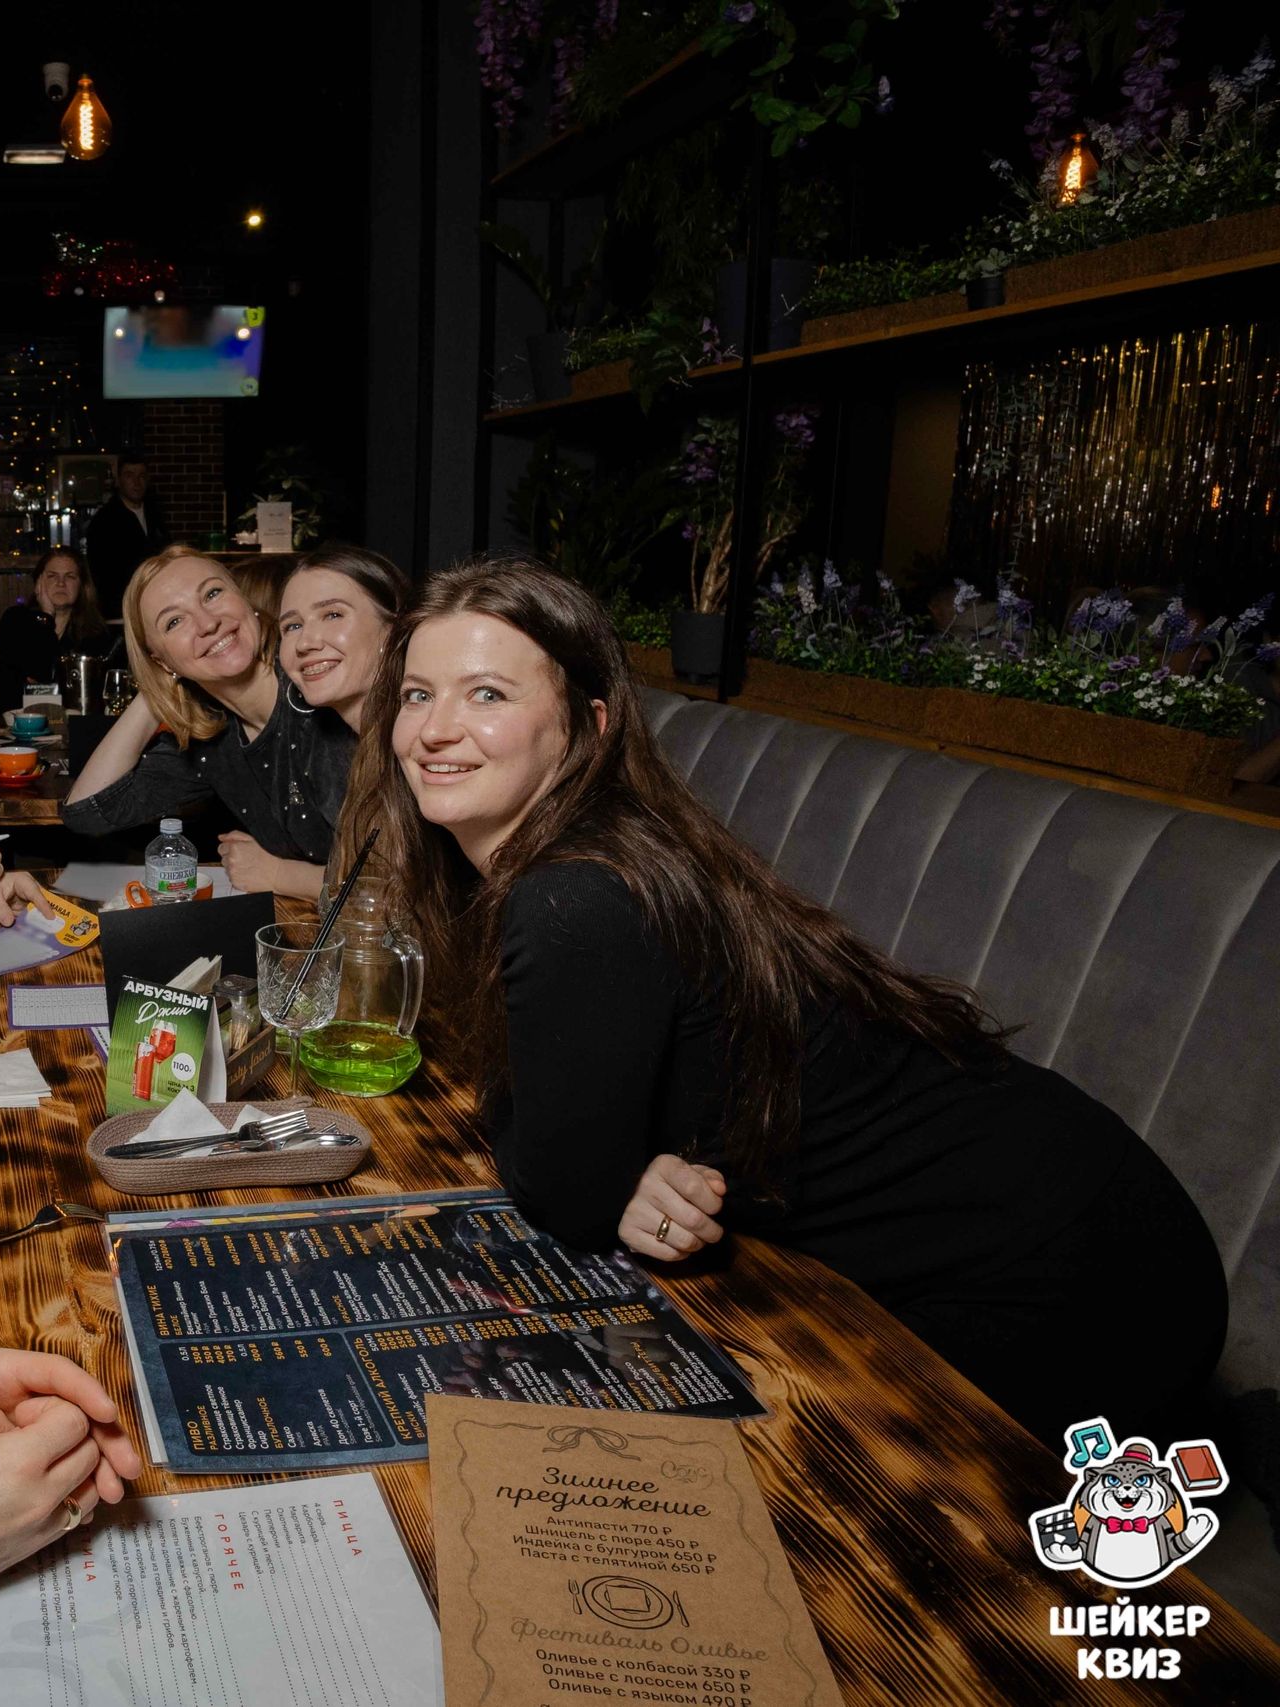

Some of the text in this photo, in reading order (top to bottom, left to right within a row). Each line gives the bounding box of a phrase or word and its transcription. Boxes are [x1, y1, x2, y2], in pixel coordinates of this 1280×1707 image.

[124, 980, 209, 1011] АРБУЗНЫЙ
[135, 1001, 193, 1024] Джин
[146, 1285, 169, 1335] ВИНА ТИХИЕ
[169, 1315, 182, 1335] БЕЛОЕ
[214, 1350, 224, 1363] 400
[363, 1333, 379, 1351] 50МЛ
[204, 1384, 218, 1409] светлое
[354, 1337, 411, 1439] КРЕПКИЙ АЛКОГОЛЬ
[627, 1382, 655, 1410] ВЕРМУТ
[317, 1388, 349, 1445] Дом 40 скелетов
[347, 1399, 360, 1415] сорт
[187, 1421, 204, 1449] ПИВО
[197, 1405, 217, 1449] РАЗЛИВНОЕ
[257, 1397, 283, 1448] БУТЫЛОЧНОЕ
[283, 1425, 296, 1448] Садко
[306, 1420, 322, 1446] Аляска
[405, 1411, 425, 1438] ВИСКИ
[257, 1430, 269, 1449] Сидр
[542, 1466, 660, 1494] Зимнее
[496, 1485, 712, 1518] предложение
[180, 1517, 194, 1552] Буженина
[252, 1516, 268, 1546] курицей
[333, 1499, 362, 1555] ПИЦЦА
[525, 1524, 595, 1540] Шницель
[598, 1533, 607, 1541] с
[611, 1535, 651, 1546] пюре
[655, 1537, 685, 1548] 450
[546, 1516, 628, 1531] Антипасти
[631, 1523, 658, 1534] 770
[194, 1515, 211, 1566] Бефстроганов
[209, 1573, 218, 1593] пюре
[215, 1513, 244, 1589] ГОРЯЧЕЕ
[238, 1511, 249, 1537] Цезарь
[247, 1543, 263, 1574] курицей
[512, 1535, 580, 1550] Индейка
[583, 1543, 592, 1552] с
[596, 1543, 669, 1559] булгуром
[673, 1550, 702, 1562] 650
[123, 1561, 133, 1582] соусе
[135, 1548, 146, 1579] корейка
[167, 1518, 179, 1546] Котлеты
[175, 1547, 187, 1578] говяжьи
[183, 1585, 197, 1620] фасолью
[520, 1547, 567, 1560] Паста
[570, 1554, 579, 1562] с
[583, 1555, 667, 1570] телятиной
[670, 1562, 700, 1574] 650
[113, 1579, 122, 1600] пюре
[153, 1519, 165, 1547] Котлеты
[161, 1549, 175, 1587] домашние
[172, 1595, 185, 1631] жареным
[180, 1633, 196, 1684] картофелем
[52, 1592, 62, 1620] грудки
[68, 1601, 77, 1623] пюре
[154, 1572, 166, 1610] говядины
[162, 1618, 174, 1648] грибов
[40, 1598, 50, 1646] картофелем
[510, 1617, 770, 1662] Фестиваль Оливье
[535, 1648, 597, 1665] Оливье
[601, 1658, 611, 1667] с
[616, 1660, 697, 1675] колбасой
[701, 1665, 734, 1679] 330
[542, 1663, 604, 1680] Оливье
[609, 1673, 619, 1682] с
[624, 1674, 697, 1690] лососем
[702, 1680, 735, 1693] 650
[548, 1678, 611, 1695] Оливье
[616, 1688, 626, 1697] с
[631, 1690, 697, 1704] языком
[702, 1694, 736, 1707] 490
